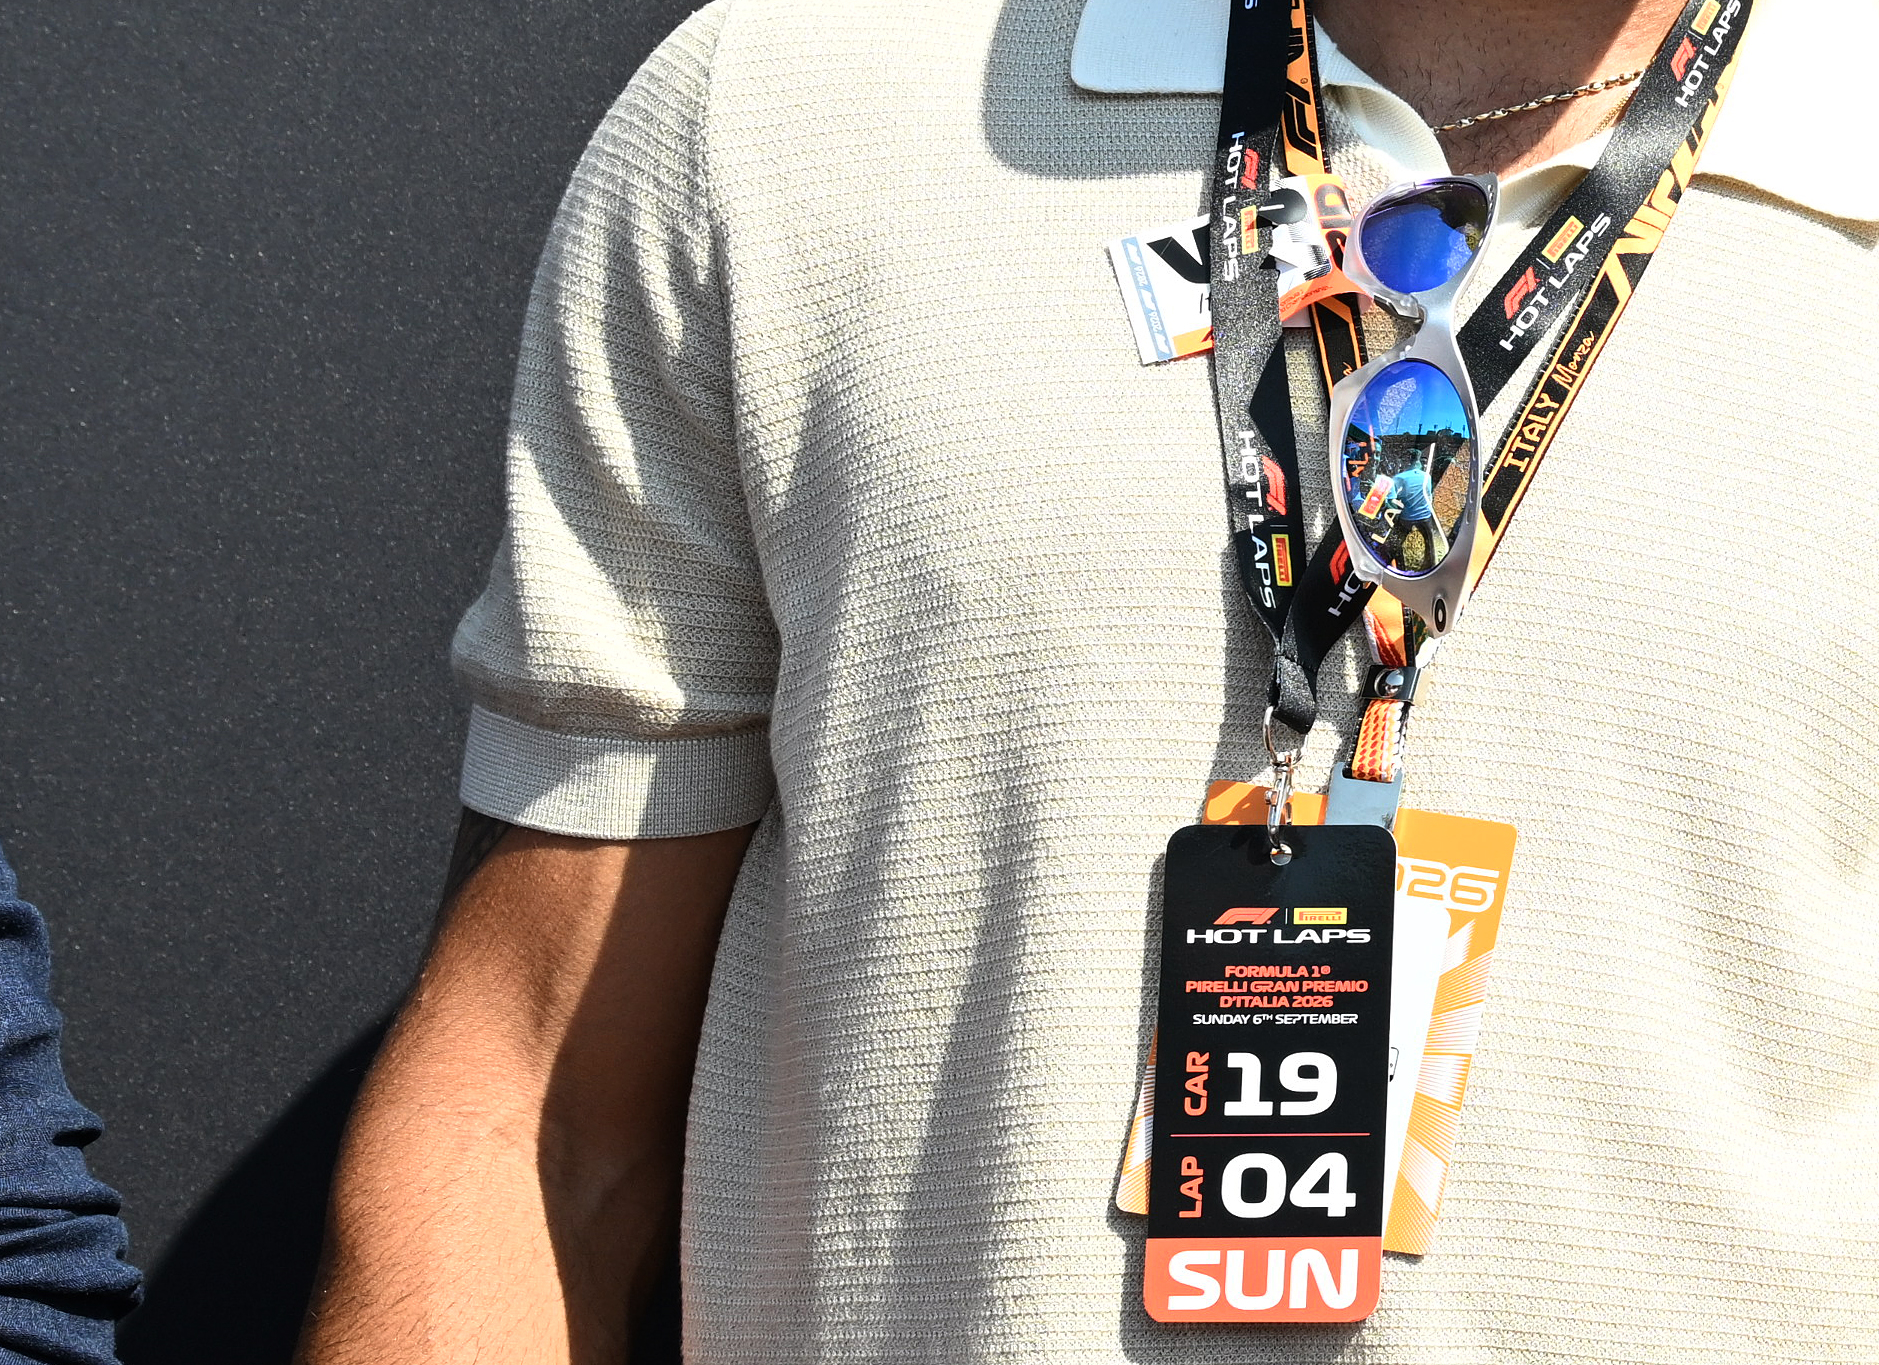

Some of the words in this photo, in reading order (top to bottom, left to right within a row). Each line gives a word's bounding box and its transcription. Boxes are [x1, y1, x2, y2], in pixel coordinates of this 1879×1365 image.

[1674, 53, 1710, 108] HOT
[1225, 131, 1245, 189] HOT
[1222, 195, 1239, 282] LAPS
[1499, 286, 1552, 352] HOT
[1548, 212, 1611, 289] LAPS
[1503, 392, 1560, 473] ITALY
[1551, 330, 1596, 391] Monza
[1238, 430, 1263, 508] HOT
[1246, 514, 1277, 609] LAPS
[1327, 569, 1361, 618] HO
[1396, 856, 1500, 913] 26
[1186, 929, 1268, 944] HOT
[1273, 928, 1371, 944] LAPS
[1298, 910, 1343, 921] PIRELLI
[1185, 980, 1248, 993] PIRELLI
[1250, 980, 1300, 993] GRAN
[1302, 980, 1369, 993] PREMIO
[1224, 965, 1309, 978] FORMULA
[1291, 995, 1334, 1008] 2026
[1192, 1013, 1251, 1025] SUNDAY
[1274, 1013, 1359, 1025] SEPTEMBER
[1184, 1051, 1210, 1116] CAR
[1223, 1051, 1338, 1116] 19
[1178, 1155, 1204, 1219] LAP
[1220, 1152, 1357, 1219] 04
[1167, 1247, 1359, 1311] SUN
